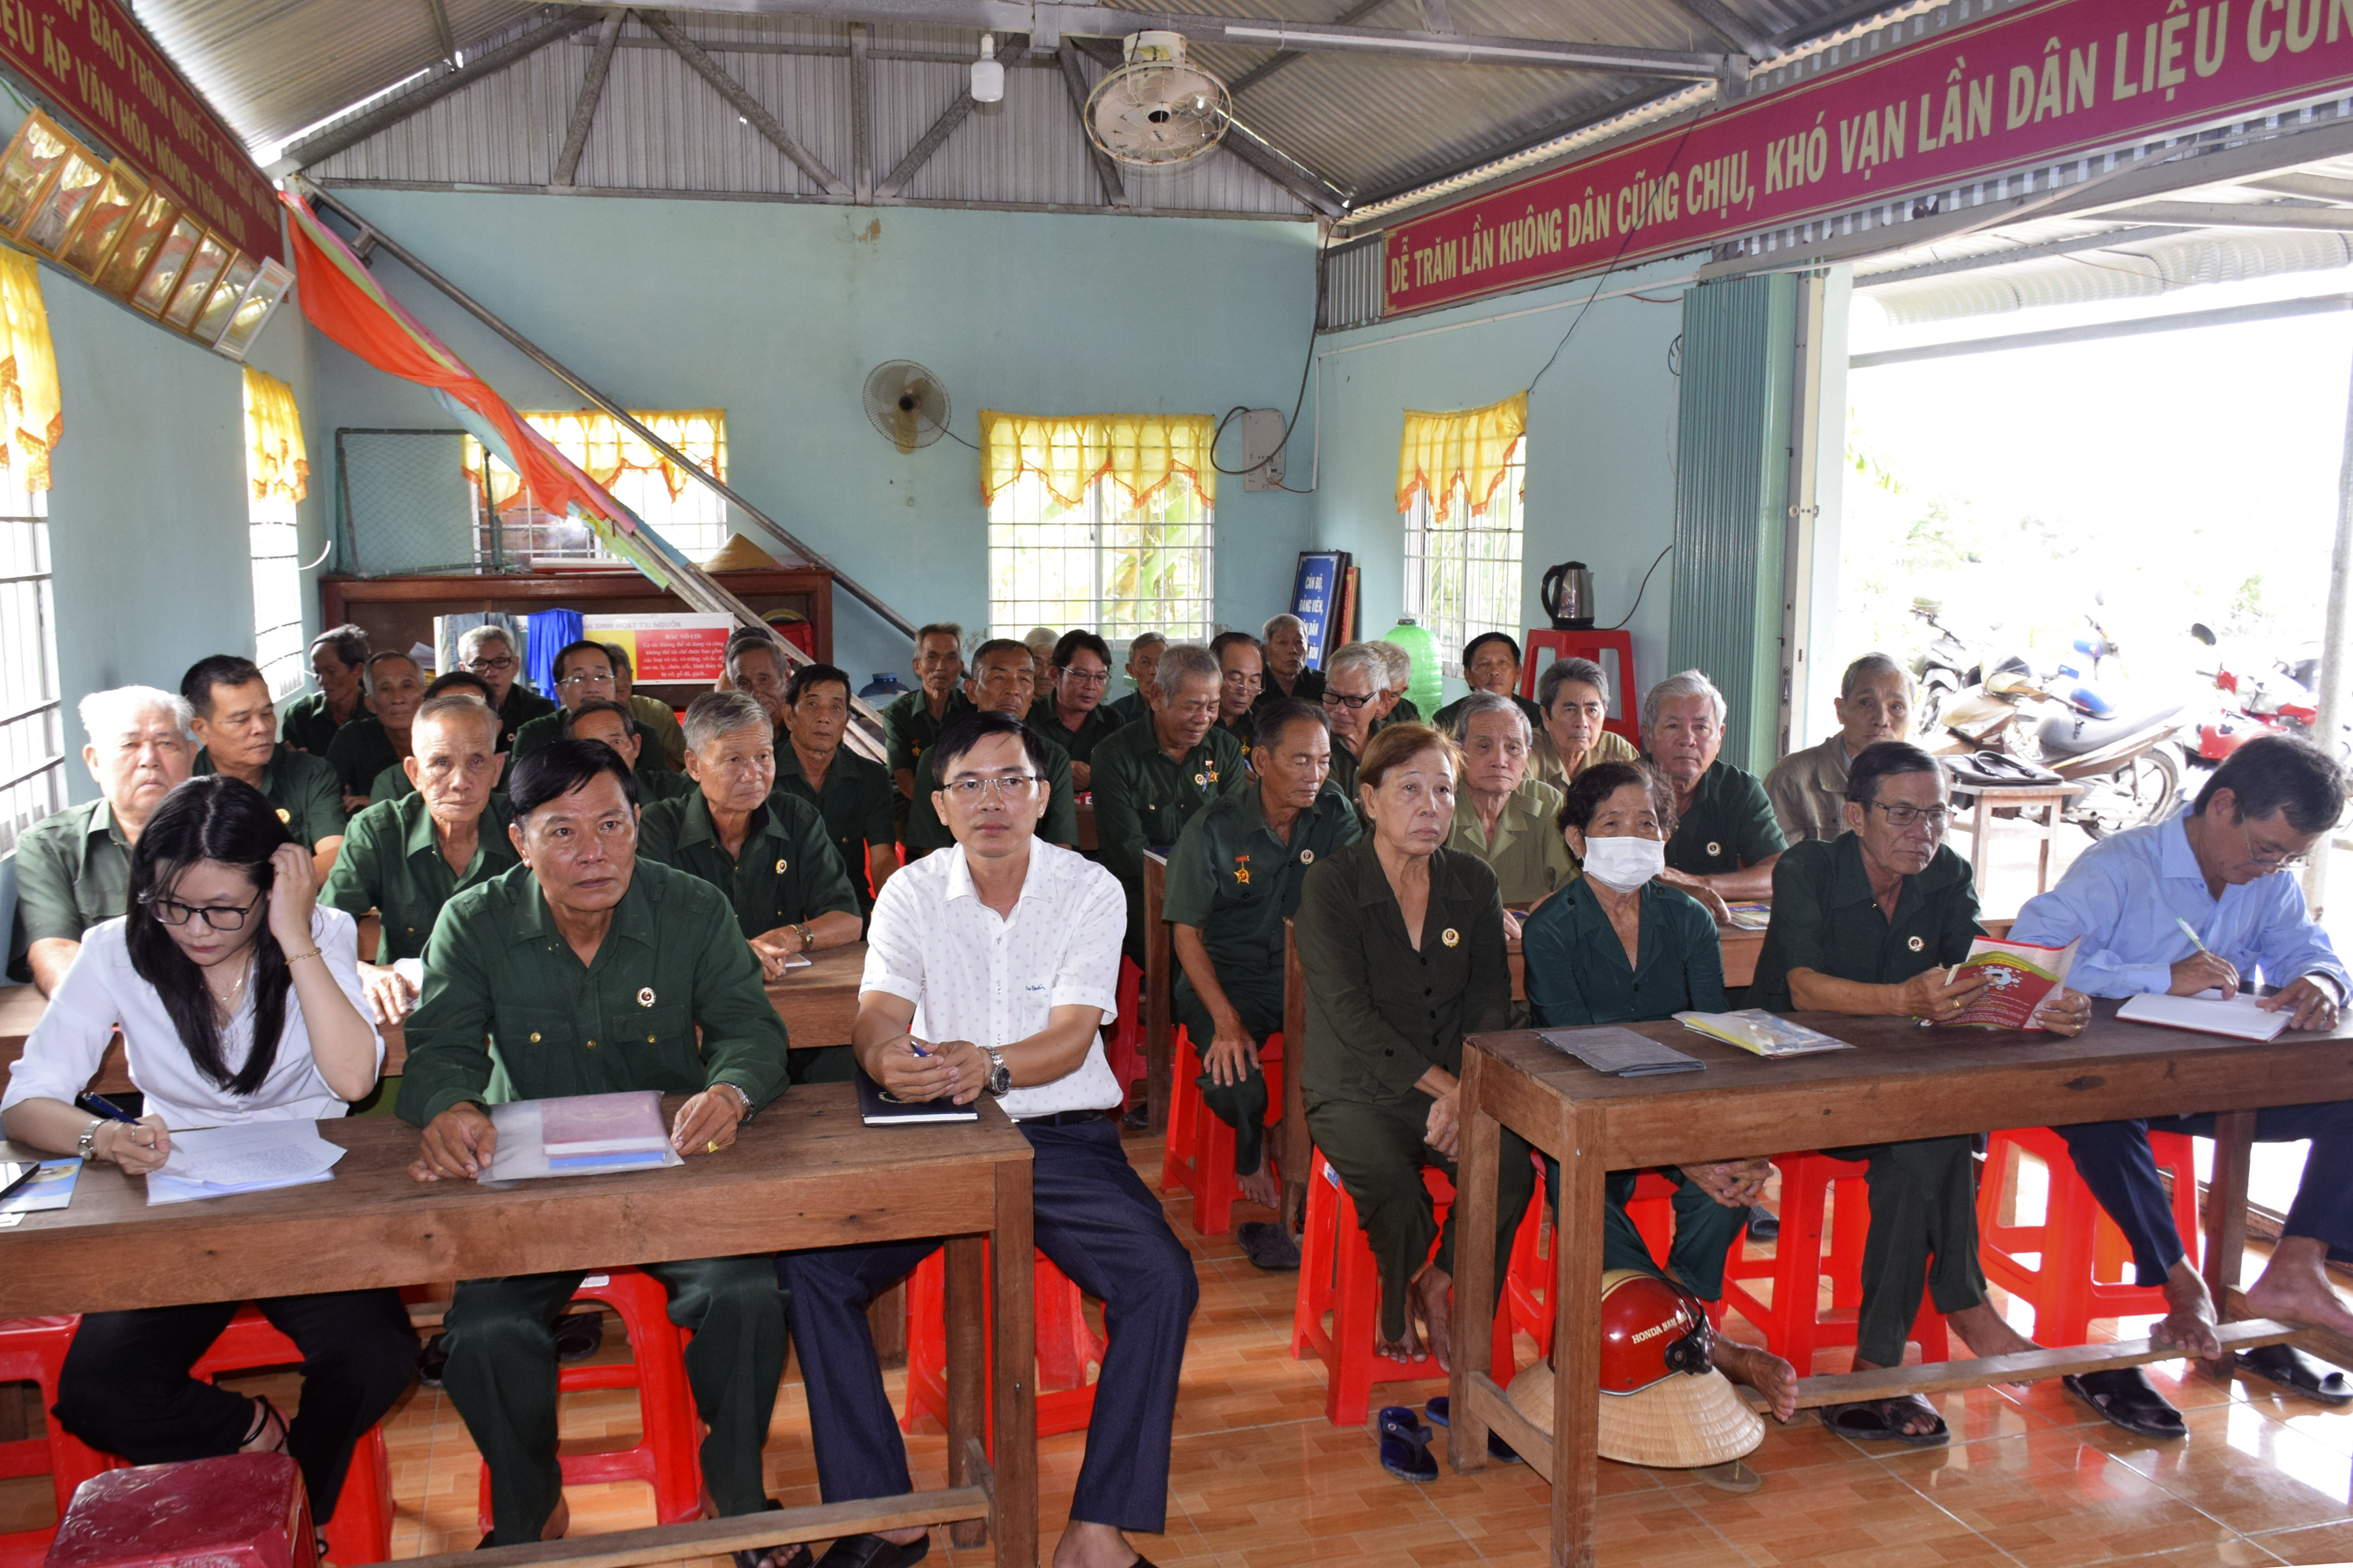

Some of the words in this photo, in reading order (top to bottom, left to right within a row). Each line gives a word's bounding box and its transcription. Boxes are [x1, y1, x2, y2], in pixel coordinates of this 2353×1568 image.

[42, 13, 71, 84] ẤP
[76, 56, 116, 128] VĂN
[119, 98, 154, 164] HÓA
[155, 135, 193, 198] NÔNG
[193, 172, 225, 226] THÔN
[1391, 236, 1409, 294] DỄ
[1415, 237, 1457, 285] TRĂM
[1462, 214, 1494, 276] LẦN
[1499, 204, 1562, 266] KHÔNG
[1568, 187, 1611, 249] DÂN
[1617, 169, 1680, 234] CŨNG
[1686, 150, 1755, 219] CHỊU,
[1764, 112, 1827, 192] KHÓ
[1839, 100, 1908, 181] VẠN
[1916, 56, 1994, 154] LẦN
[2006, 36, 2098, 131] DÂN
[2112, 1, 2229, 102] LIỆU
[1631, 1325, 1663, 1345] HONDA
